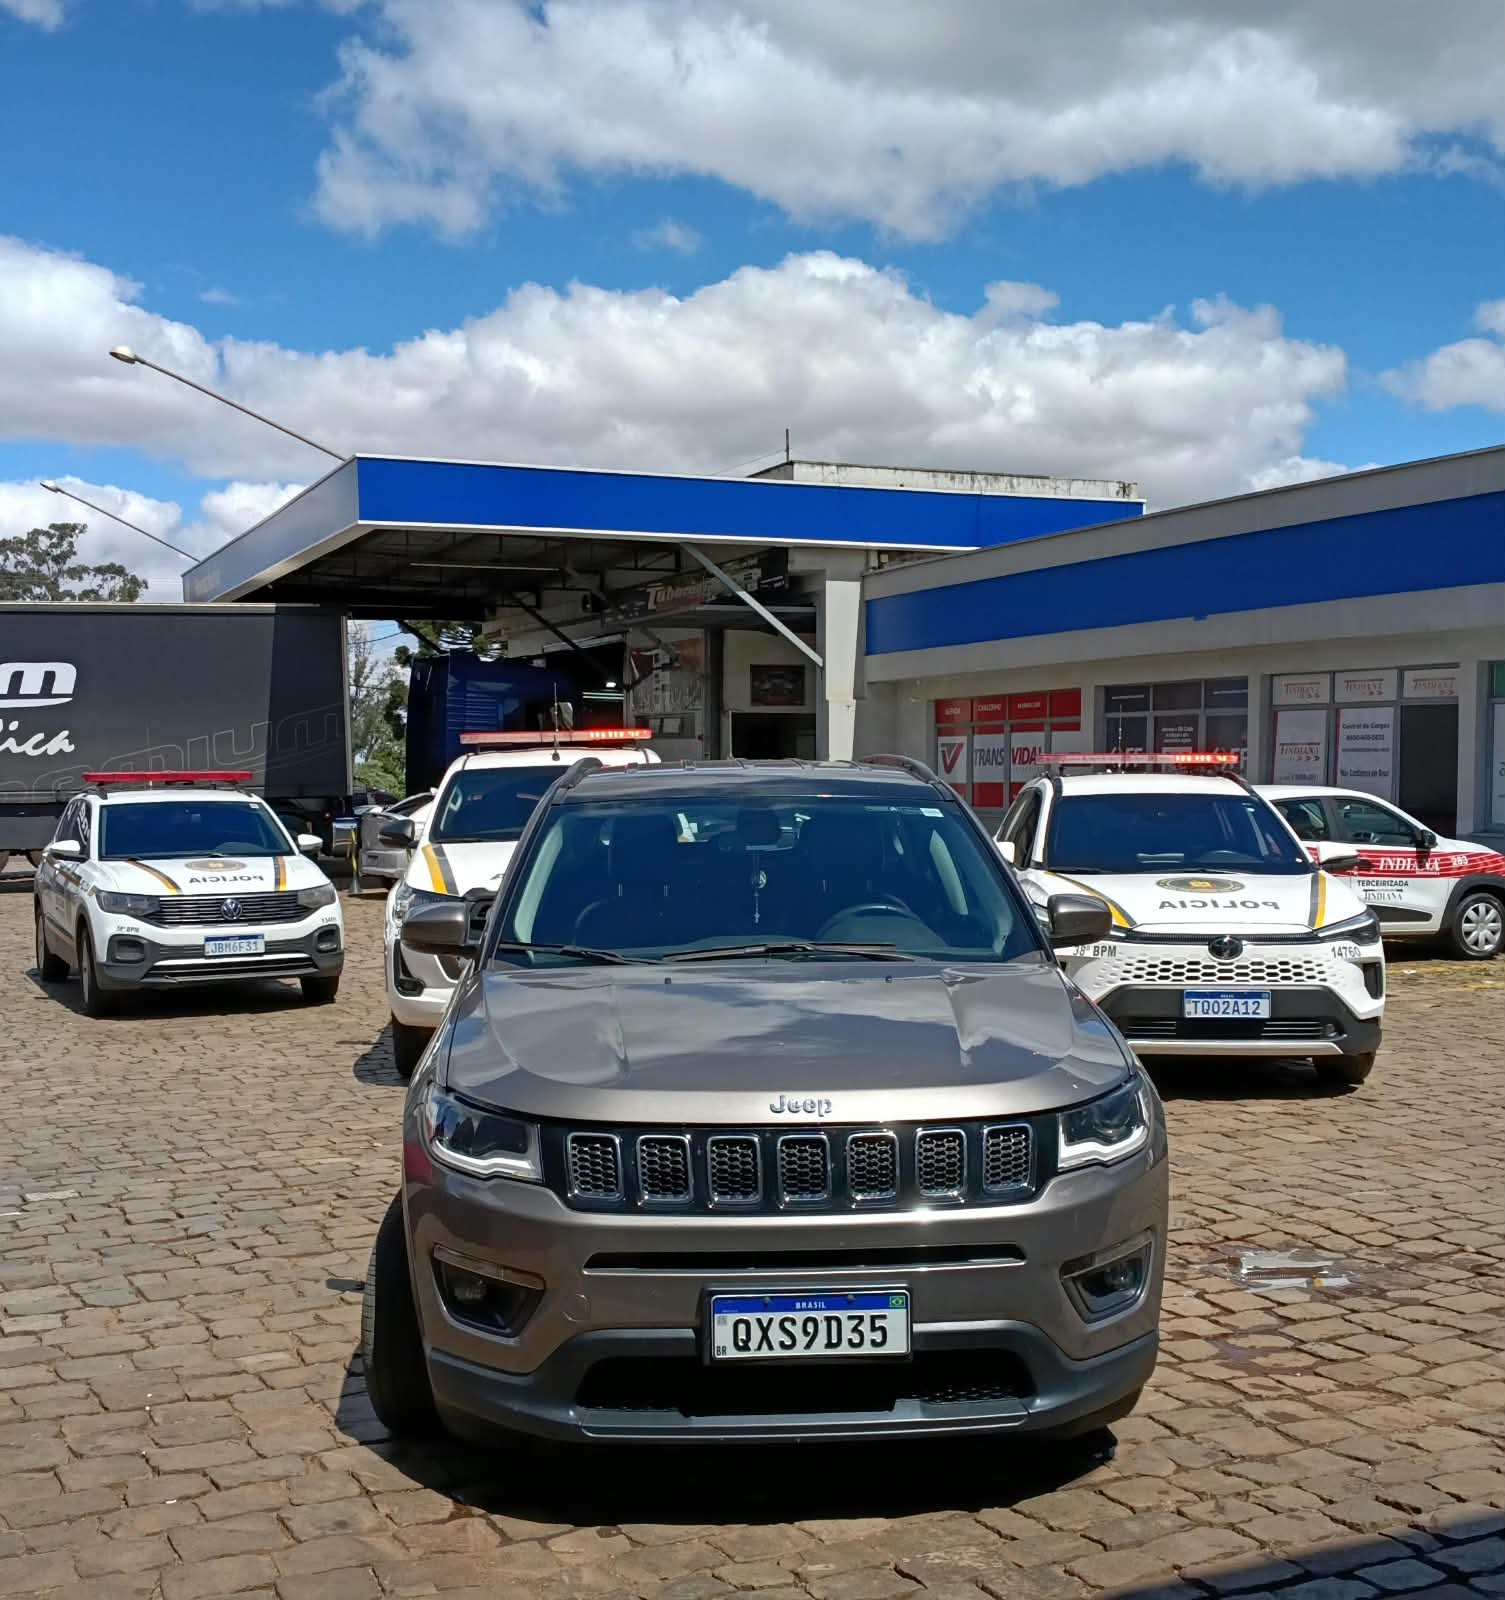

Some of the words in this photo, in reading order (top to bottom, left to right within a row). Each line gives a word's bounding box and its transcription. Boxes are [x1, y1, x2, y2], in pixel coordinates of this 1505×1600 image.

[974, 747, 1005, 766] TRANS
[1357, 879, 1409, 888] TERCEIRIZADA
[1092, 944, 1117, 957] BPM
[769, 1095, 832, 1117] Jeep
[795, 1301, 826, 1309] BRASIL
[732, 1314, 888, 1352] QXS9D35
